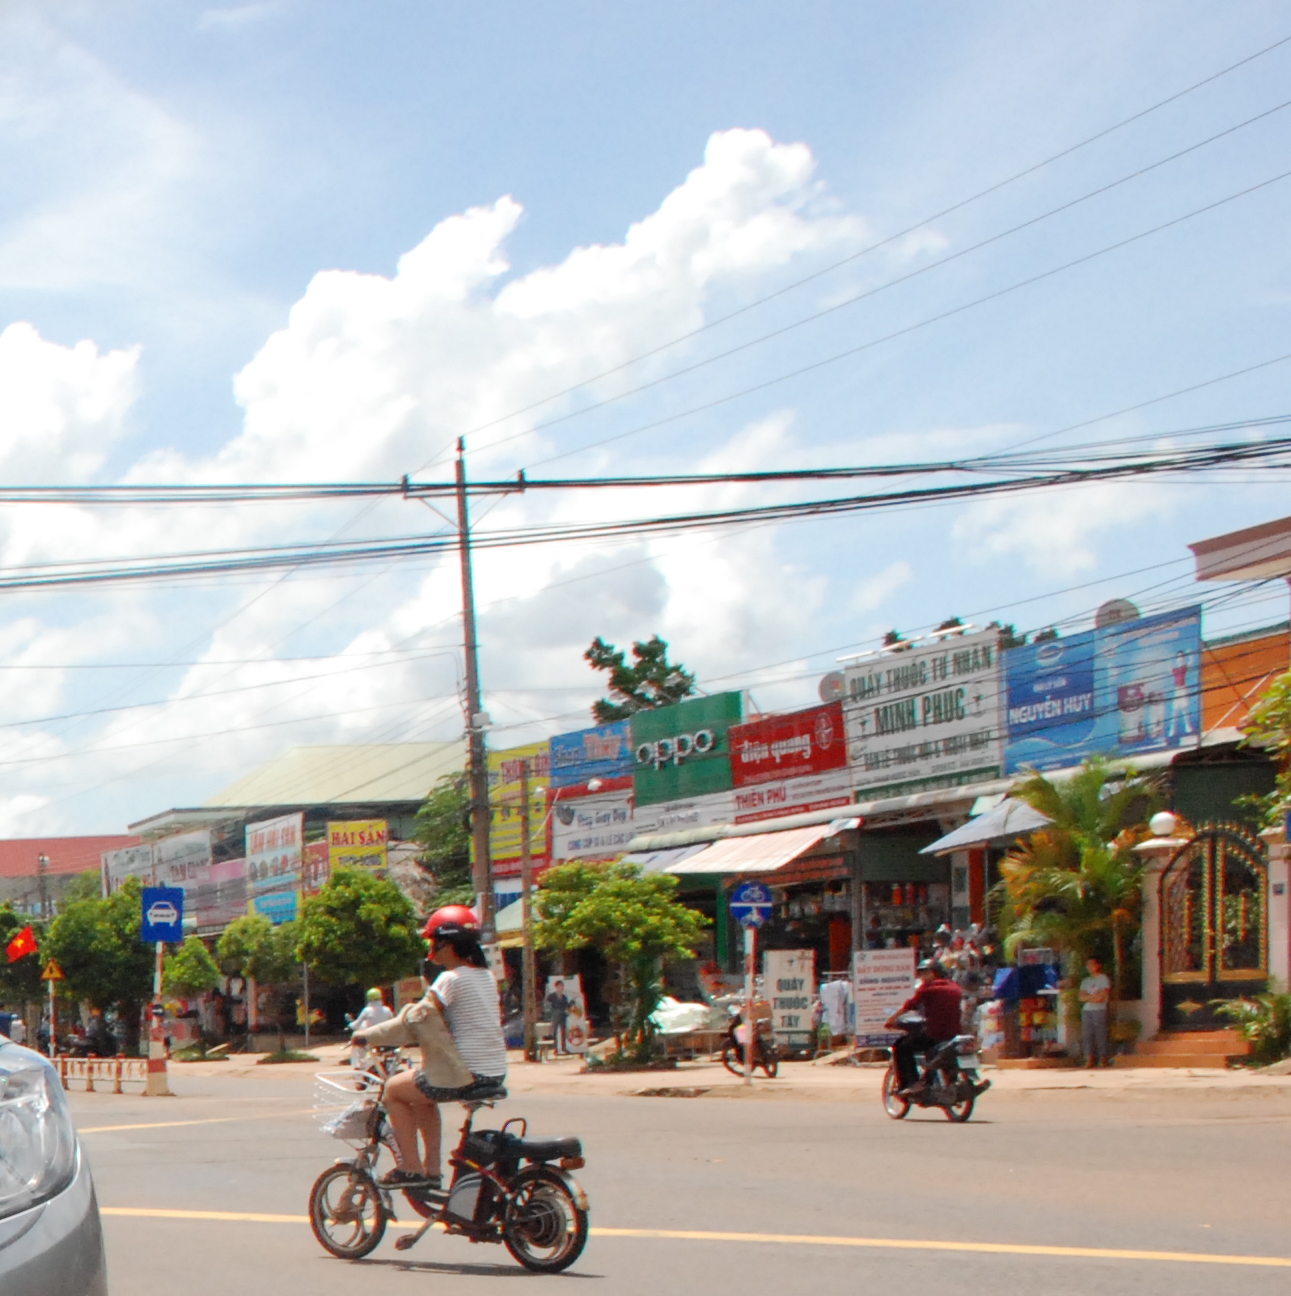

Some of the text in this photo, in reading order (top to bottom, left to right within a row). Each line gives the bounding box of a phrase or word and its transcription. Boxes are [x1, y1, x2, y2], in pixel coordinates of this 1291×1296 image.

[874, 698, 917, 736] MINH
[1063, 693, 1092, 715] HUY
[636, 729, 716, 771] oppo
[771, 733, 812, 764] quang
[332, 824, 386, 846] HẢI SẢN
